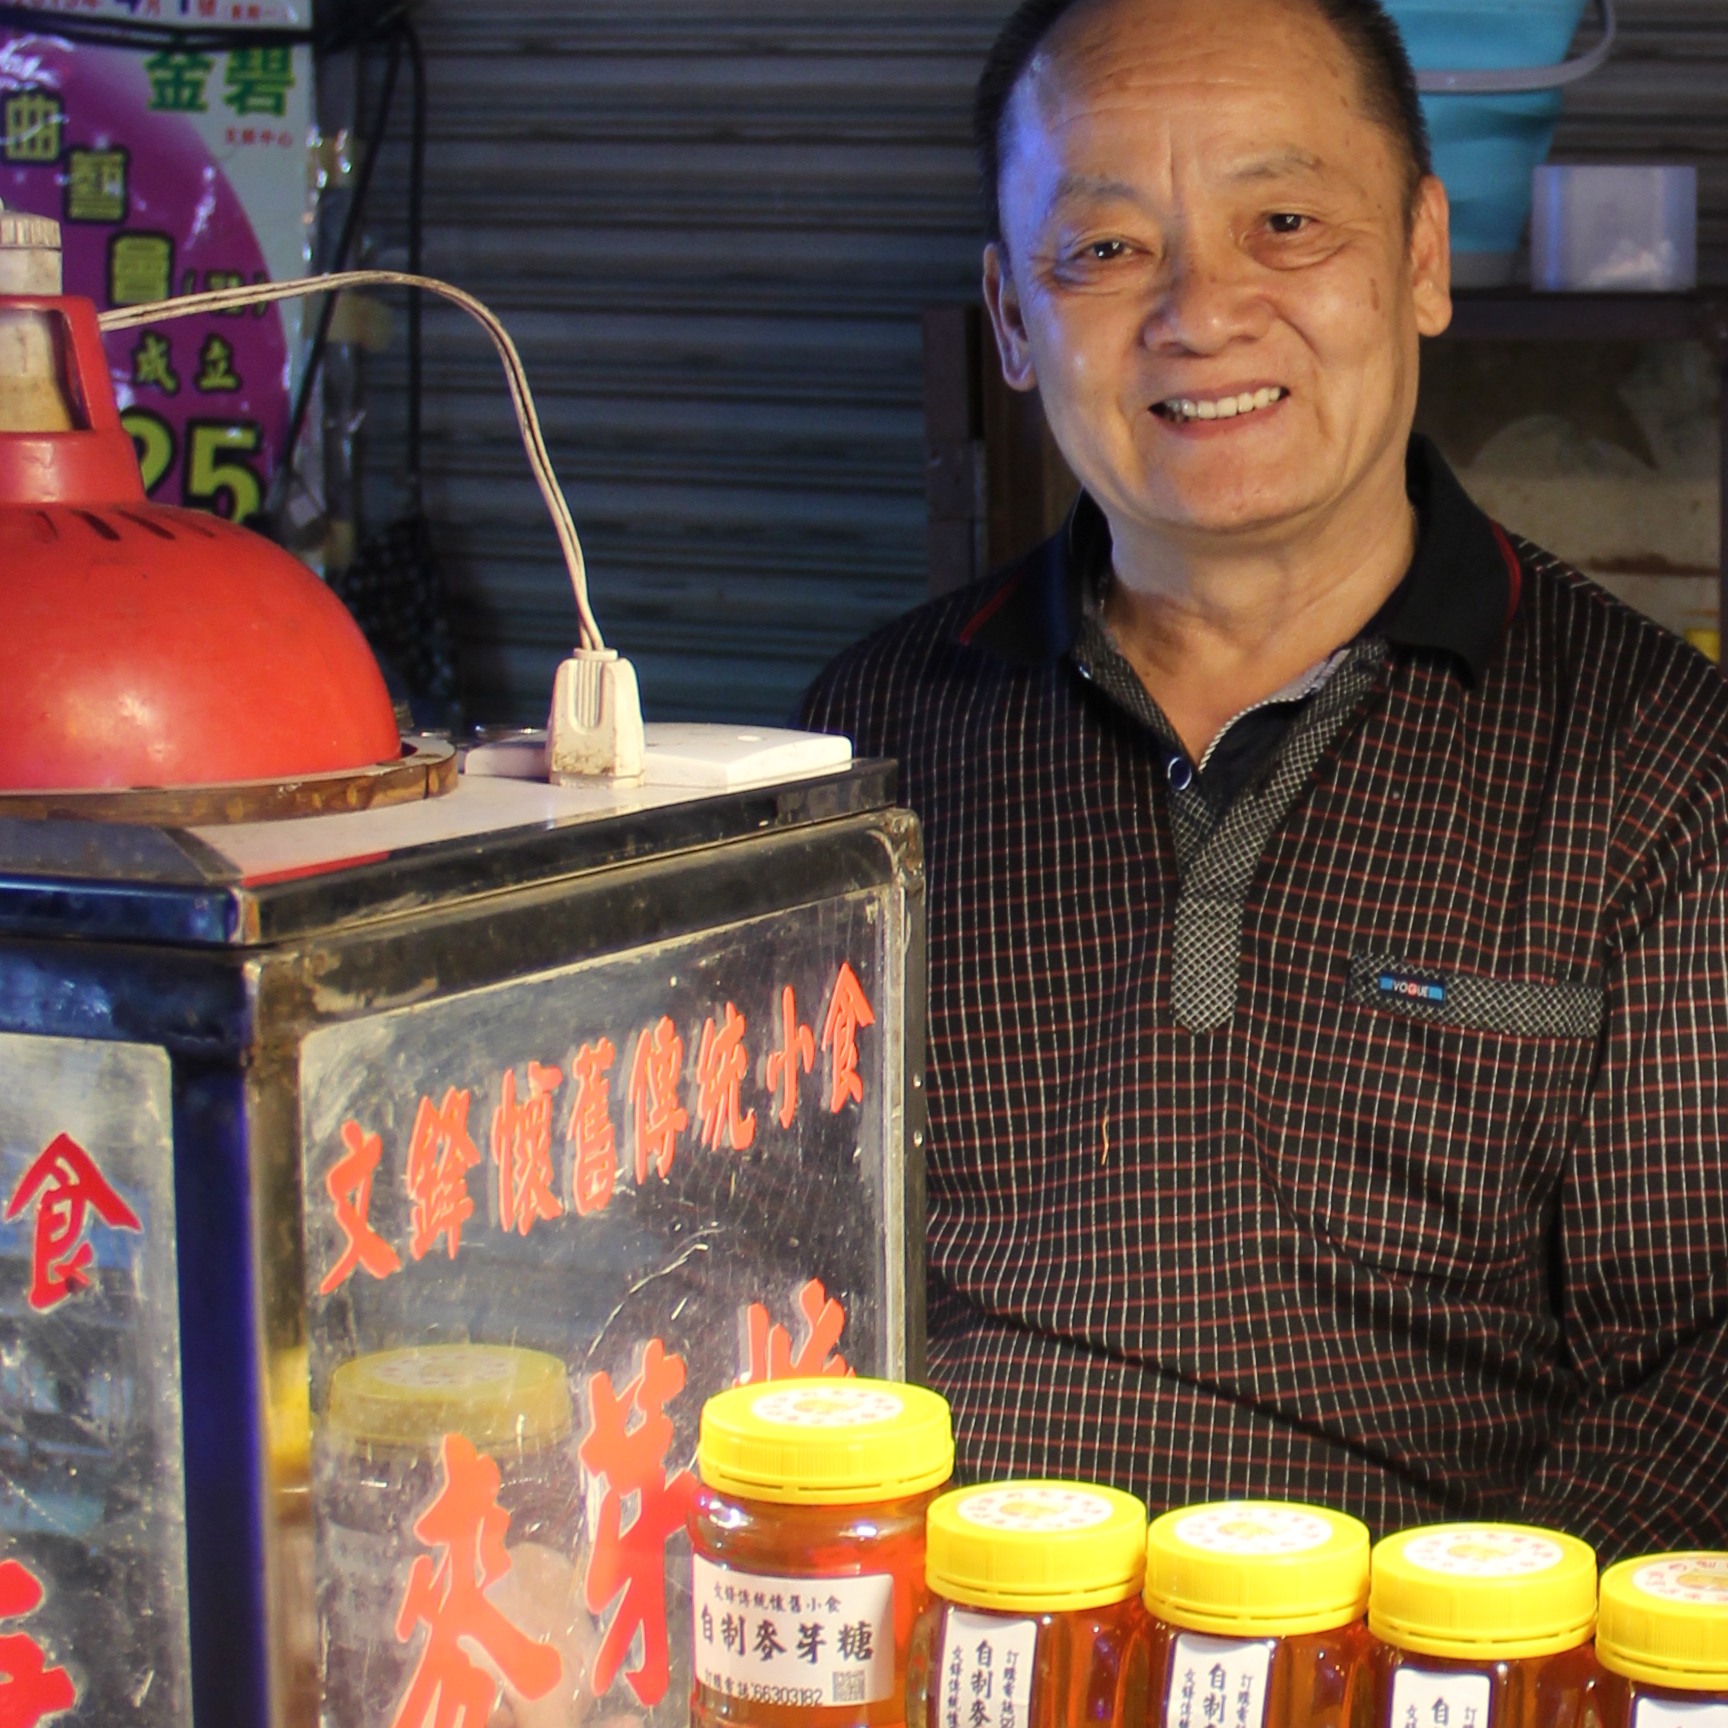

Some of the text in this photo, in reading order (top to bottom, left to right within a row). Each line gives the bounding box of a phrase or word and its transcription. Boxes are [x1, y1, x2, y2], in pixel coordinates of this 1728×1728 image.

[1393, 980, 1430, 1000] VOGUE
[320, 962, 875, 1295] 文鋒懷舊傳統小食
[701, 1602, 874, 1664] 自制麥芽糖
